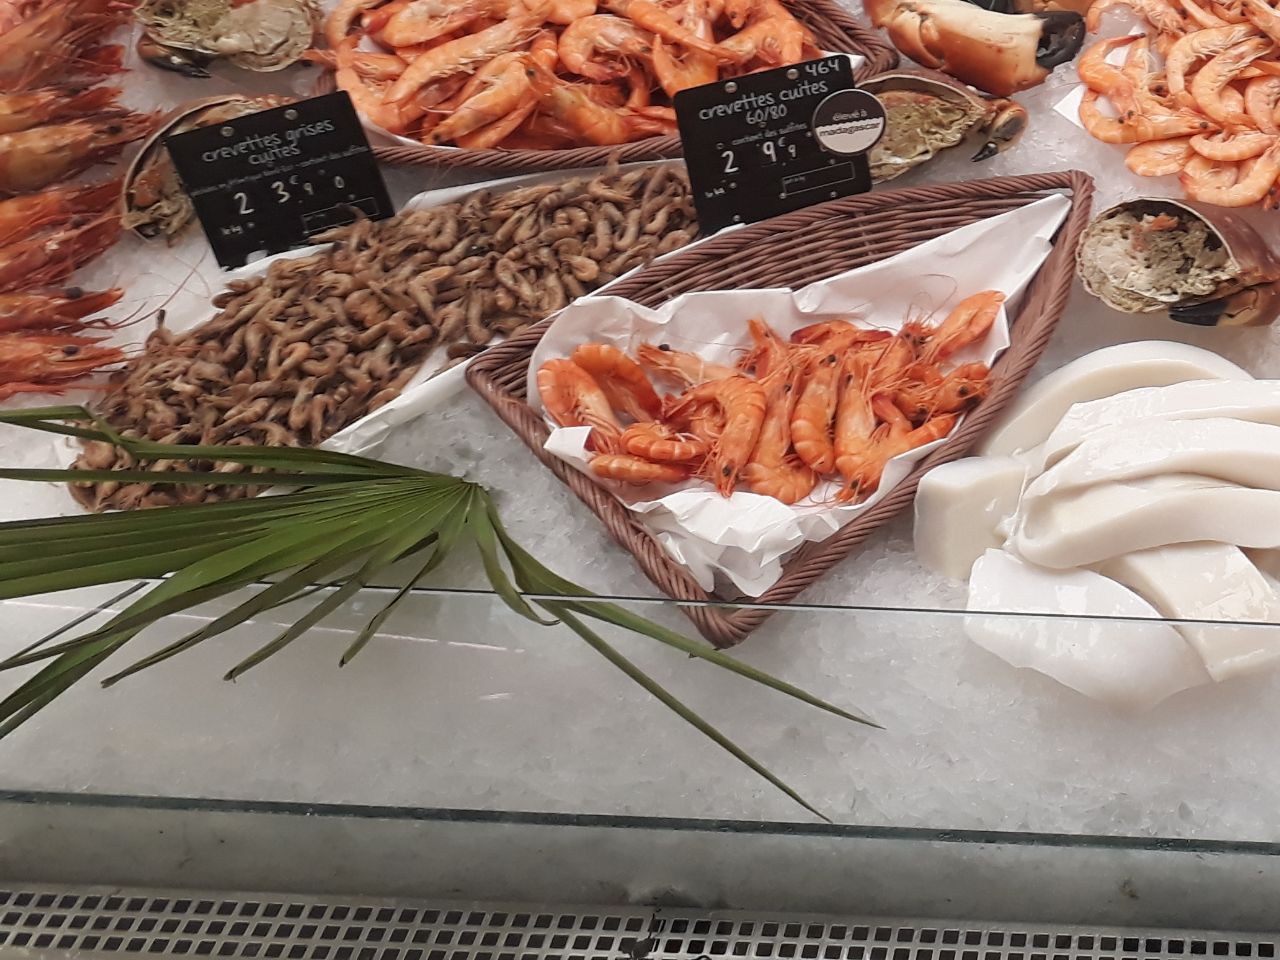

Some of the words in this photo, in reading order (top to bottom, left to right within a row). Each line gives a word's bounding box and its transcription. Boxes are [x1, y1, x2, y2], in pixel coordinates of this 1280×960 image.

[805, 59, 840, 77] 464
[699, 91, 775, 120] crevettes
[779, 80, 828, 101] cuites
[745, 104, 788, 125] 60/80
[819, 122, 881, 137] madagascar
[201, 131, 281, 162] crevettes
[285, 119, 335, 146] grises
[248, 143, 301, 165] cuites
